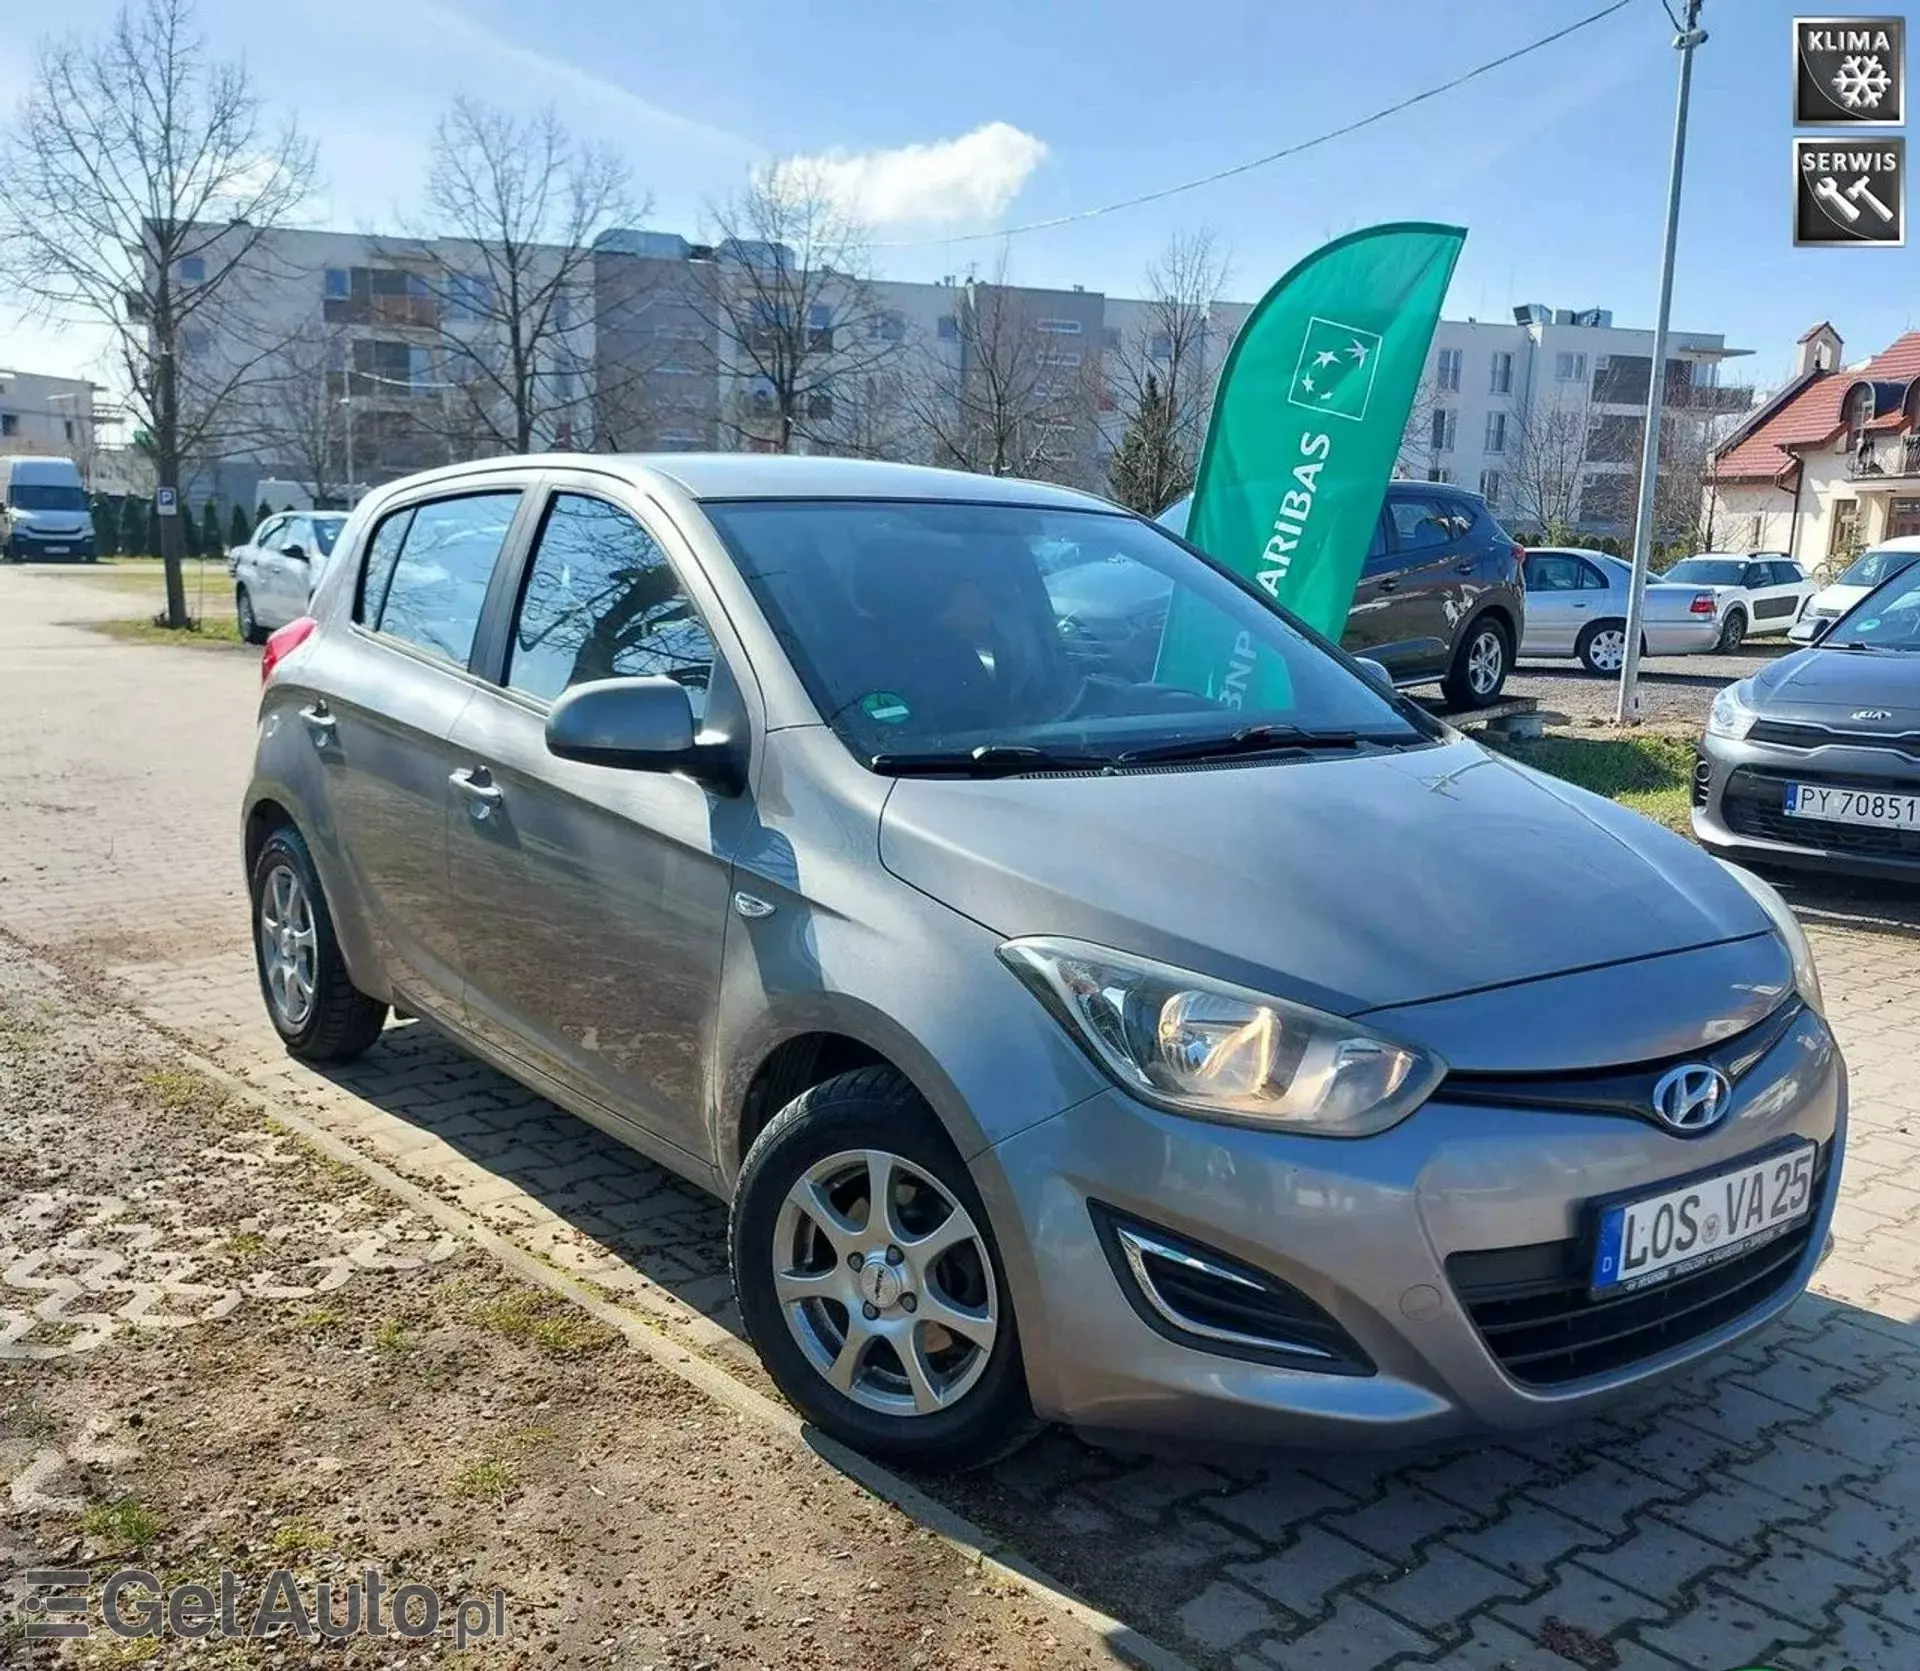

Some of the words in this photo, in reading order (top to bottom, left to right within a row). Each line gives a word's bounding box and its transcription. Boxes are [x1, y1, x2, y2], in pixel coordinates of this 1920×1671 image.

[1255, 432, 1331, 598] ARIBAS
[1801, 788, 1831, 812] PY
[1840, 793, 1915, 822] 70851
[1623, 1194, 1701, 1270] LOS
[1726, 1171, 1764, 1234] VA
[1770, 1154, 1811, 1219] 25
[1602, 1256, 1612, 1273] D
